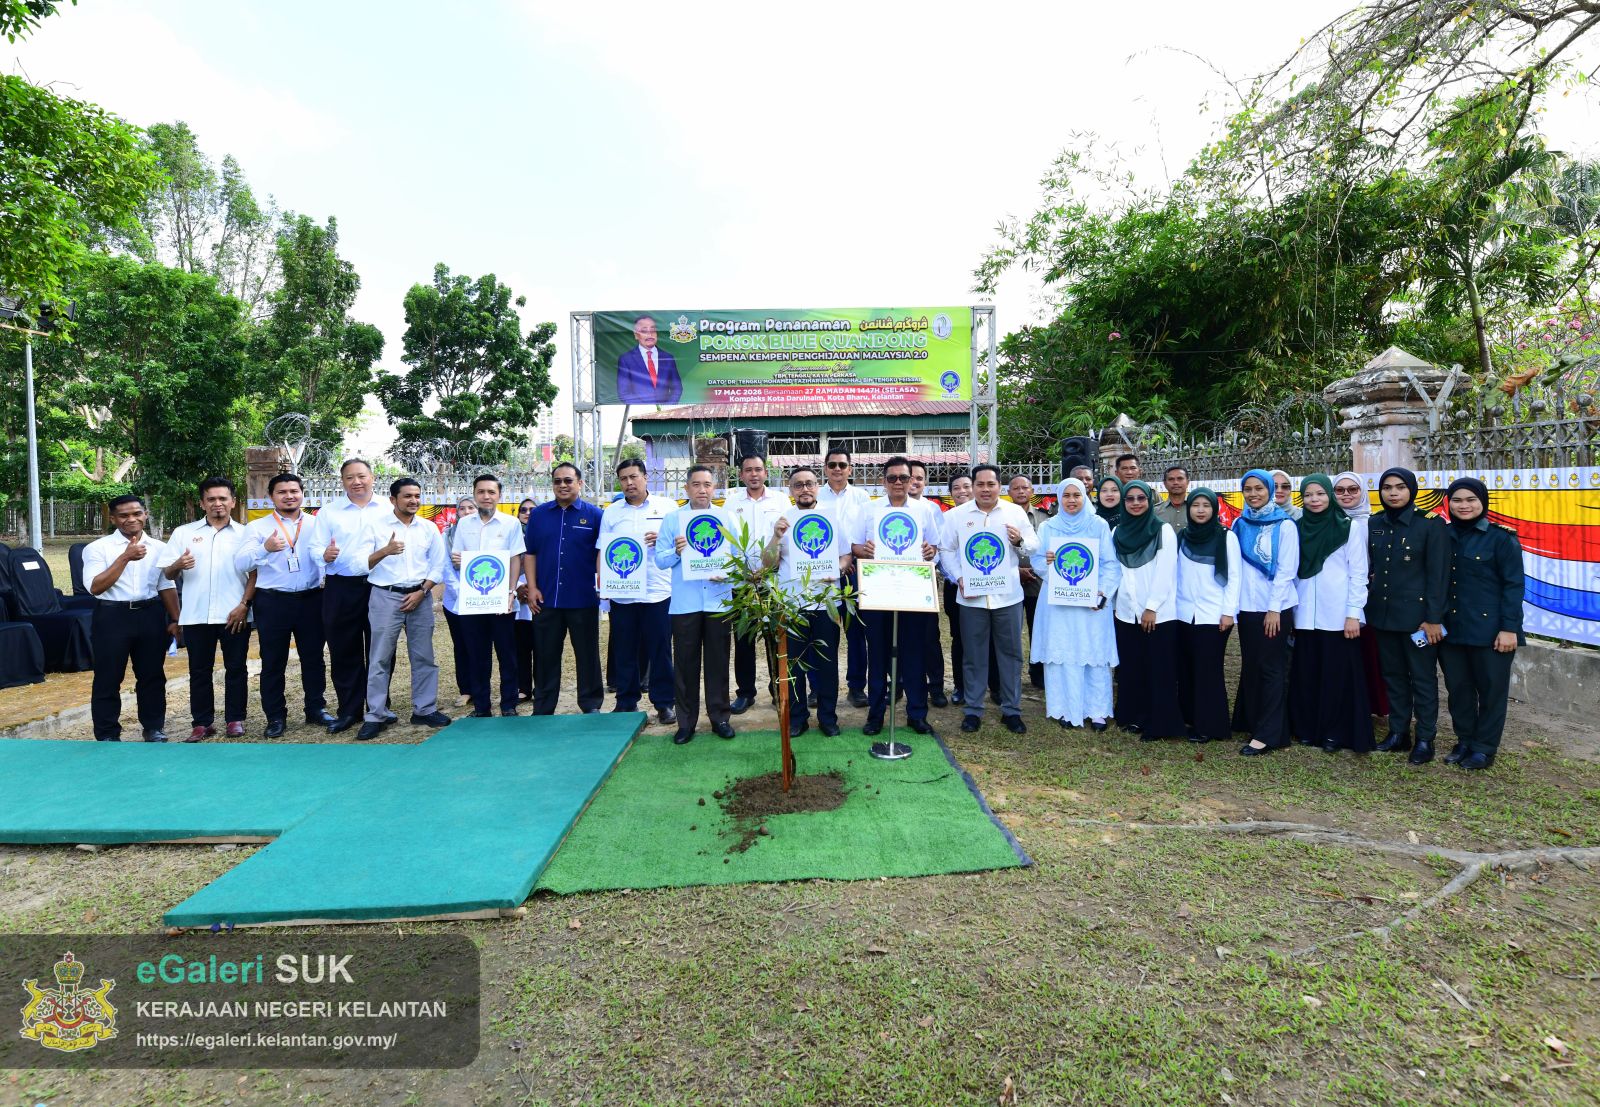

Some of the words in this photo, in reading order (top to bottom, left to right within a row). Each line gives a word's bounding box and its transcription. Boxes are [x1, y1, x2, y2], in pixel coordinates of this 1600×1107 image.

[699, 319, 761, 335] Program
[765, 318, 851, 332] Penanaman
[700, 334, 767, 350] POKOK
[769, 333, 818, 349] BLUE
[820, 332, 928, 351] QUANDONG
[700, 353, 747, 361] SEMPENA
[749, 353, 789, 361] KEMPEN
[791, 352, 860, 360] PENGHIJAUAN
[863, 351, 912, 359] MALAYSIA
[914, 351, 928, 359] 2.0
[729, 395, 766, 403] Kompleks
